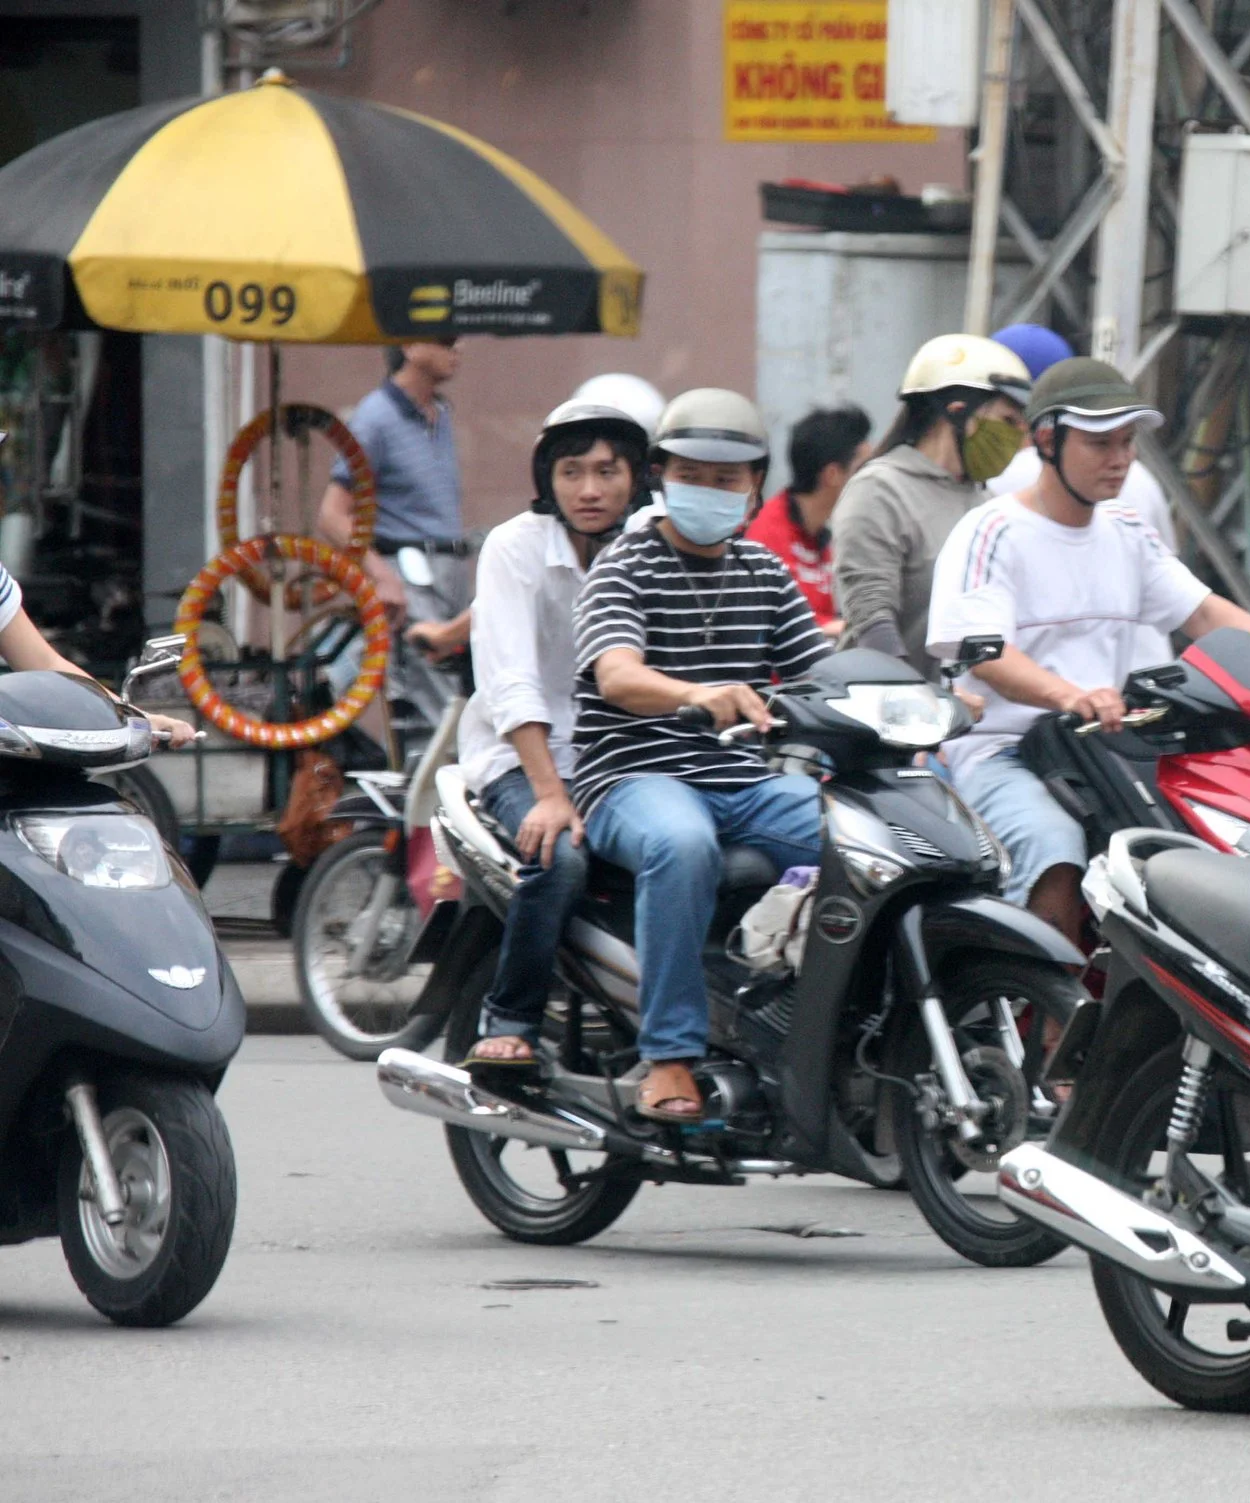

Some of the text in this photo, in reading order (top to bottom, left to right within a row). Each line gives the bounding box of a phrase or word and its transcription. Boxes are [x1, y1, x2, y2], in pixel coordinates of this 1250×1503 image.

[735, 51, 844, 100] KHÔNG
[204, 280, 297, 325] 099
[453, 279, 533, 307] Beeline
